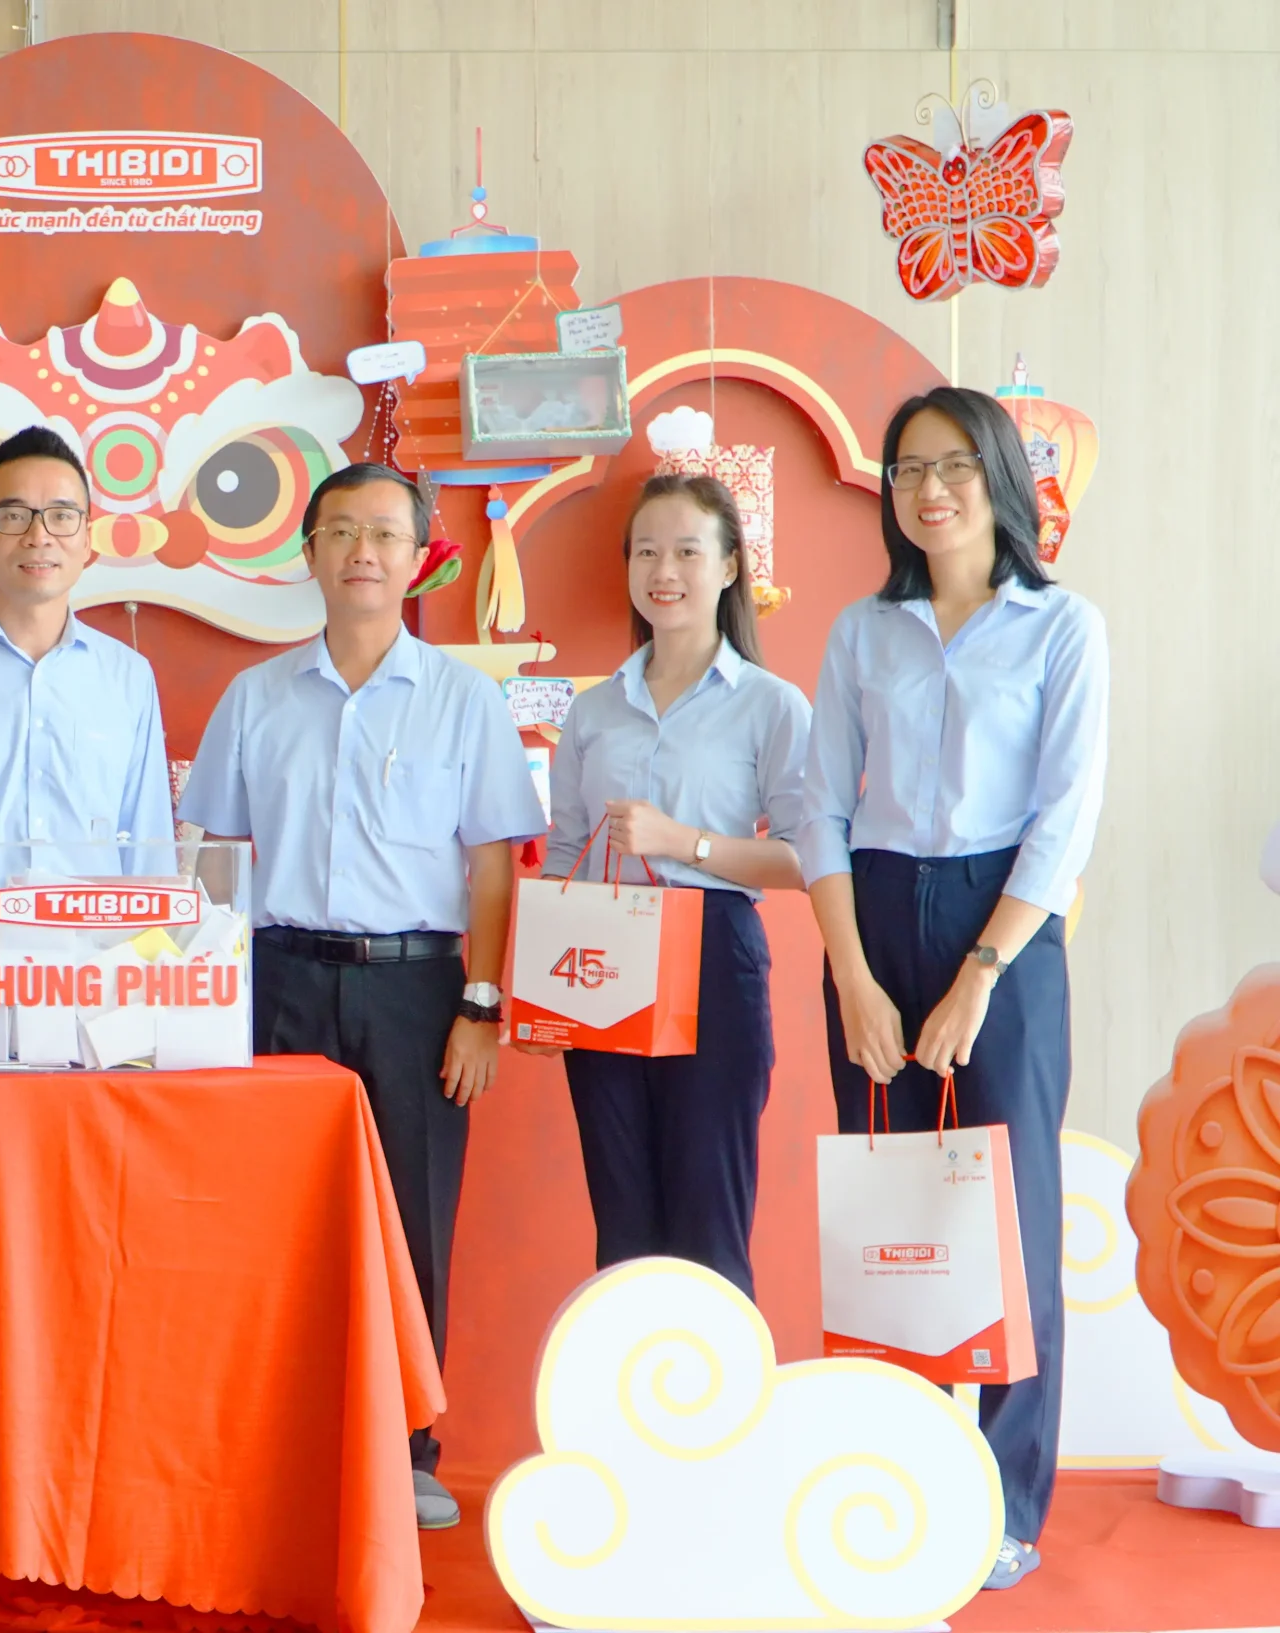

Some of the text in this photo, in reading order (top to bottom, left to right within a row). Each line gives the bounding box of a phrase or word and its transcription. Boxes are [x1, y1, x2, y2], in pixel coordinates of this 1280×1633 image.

[49, 148, 203, 177] THIBIDI
[100, 178, 153, 187] SINCE 1980
[26, 212, 81, 231] mạnh
[86, 209, 123, 228] đến
[153, 208, 197, 227] chất
[45, 894, 160, 914] THIBIDI
[116, 951, 239, 1007] PHIẾU
[550, 947, 619, 989] 45 THIBIDI
[884, 1247, 932, 1258] THIBIDI
